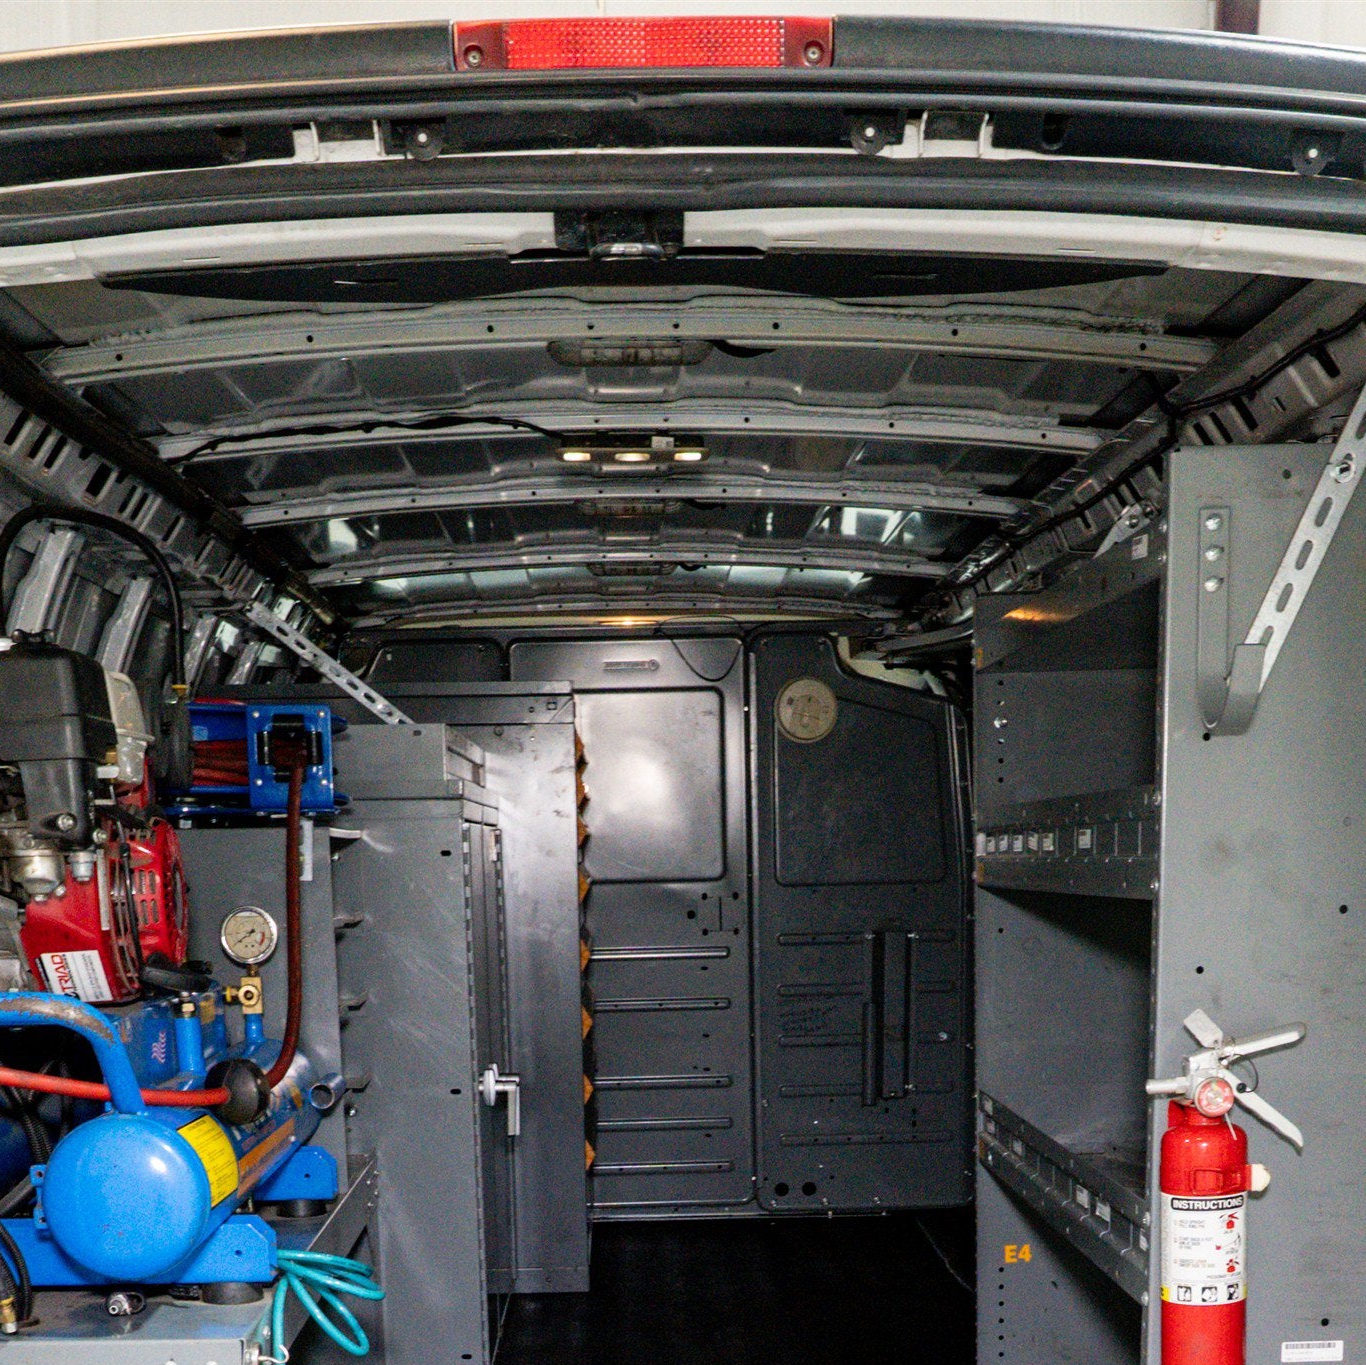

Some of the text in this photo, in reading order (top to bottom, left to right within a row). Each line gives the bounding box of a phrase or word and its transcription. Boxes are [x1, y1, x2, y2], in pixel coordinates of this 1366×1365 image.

[50, 954, 77, 993] TRIAD
[1172, 1197, 1243, 1210] INSTRUCTIONS
[1003, 1244, 1033, 1264] E4
